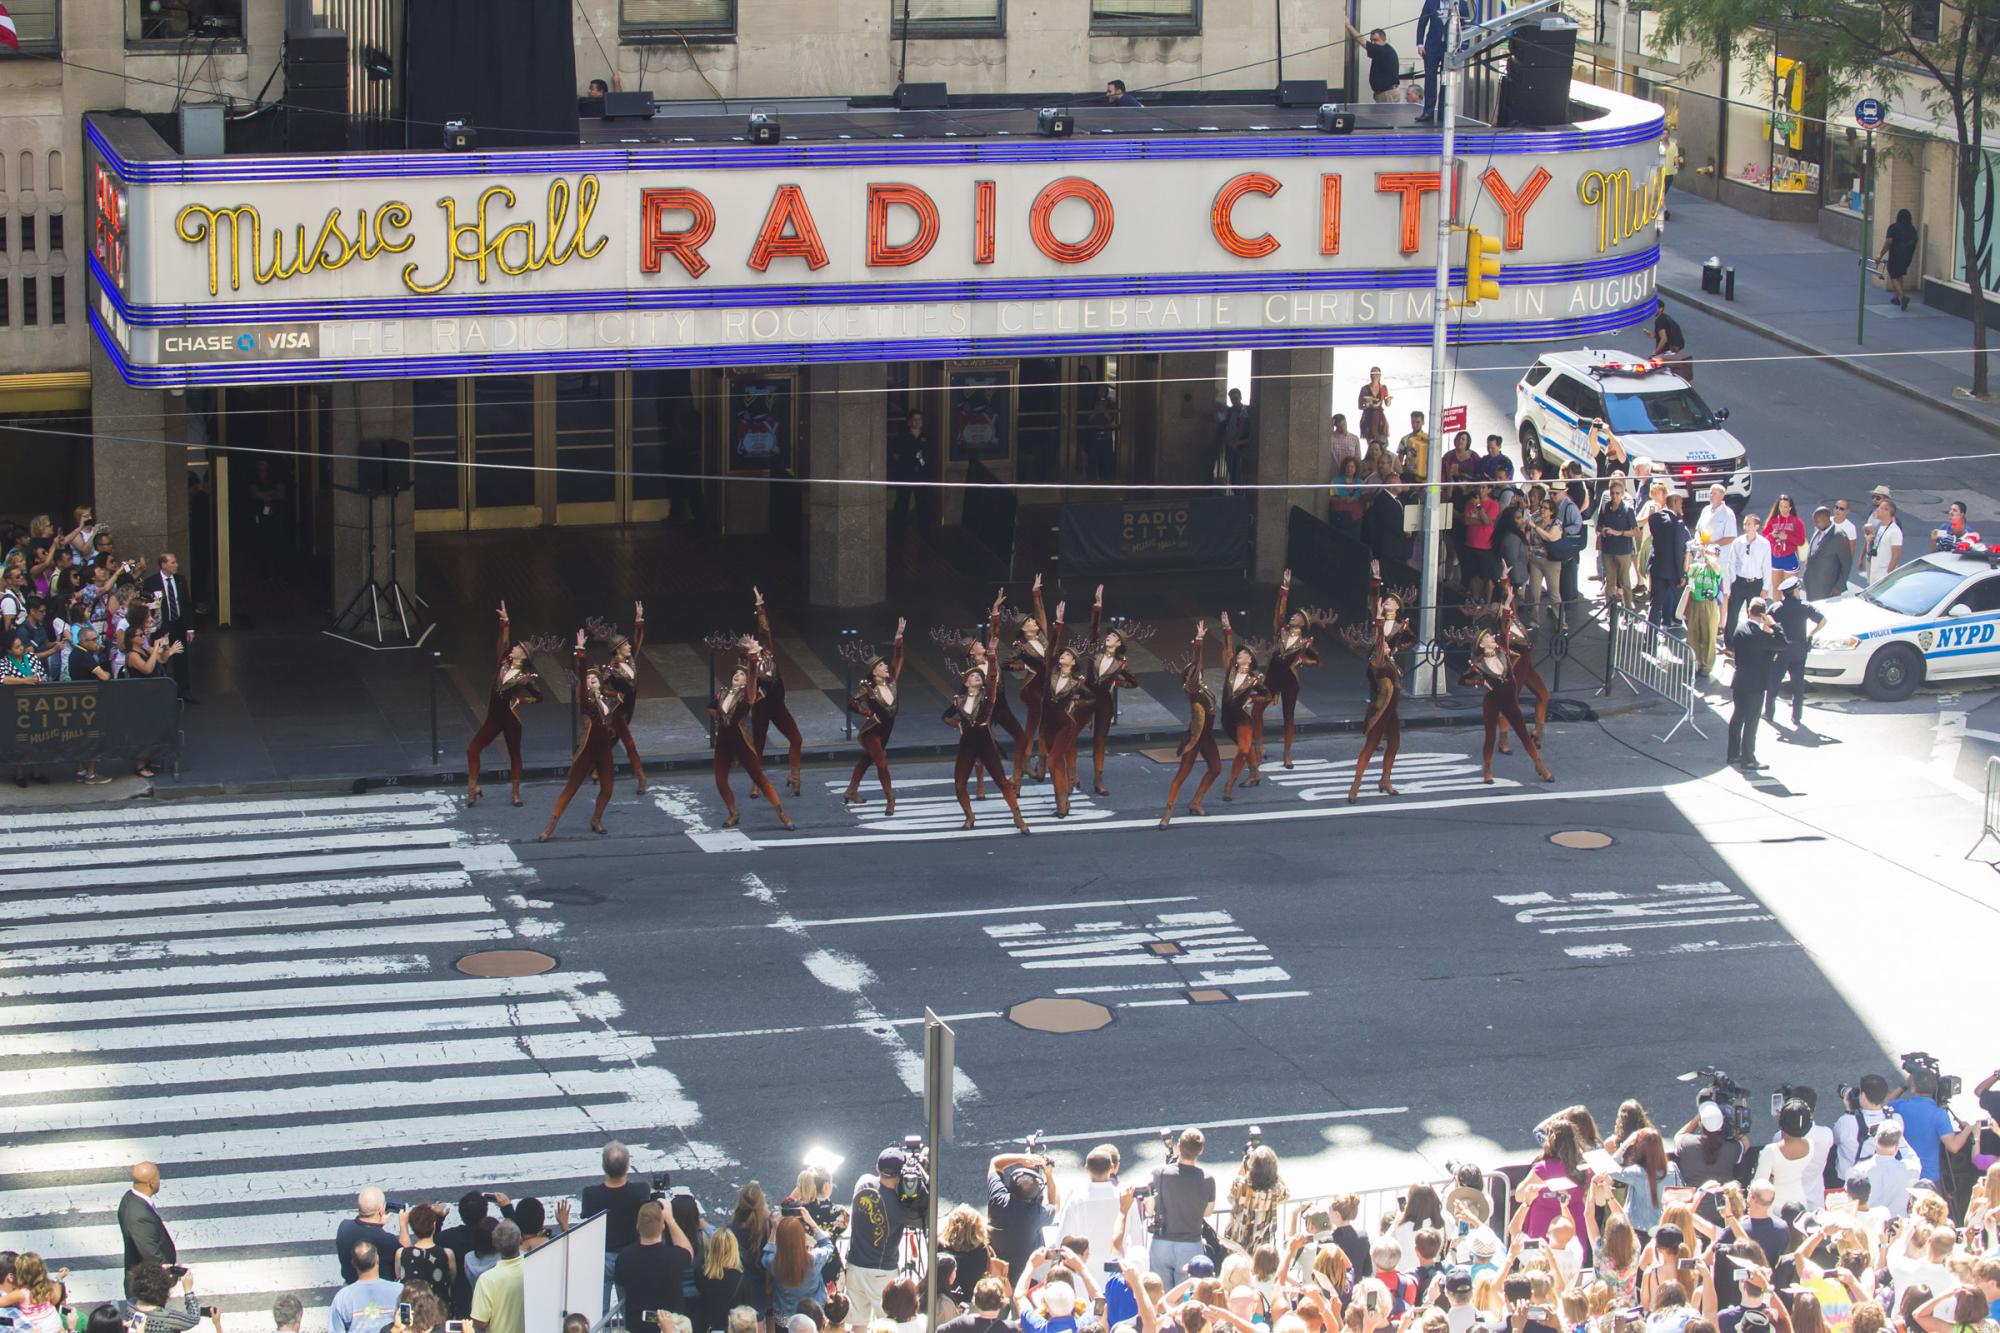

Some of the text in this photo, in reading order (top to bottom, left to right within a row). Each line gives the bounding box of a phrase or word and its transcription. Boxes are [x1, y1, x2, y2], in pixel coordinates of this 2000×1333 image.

[640, 166, 1553, 279] RADIO CITY
[175, 200, 414, 296] Music
[403, 174, 608, 294] Hall
[322, 321, 400, 355] THE
[435, 315, 565, 350] RADIO
[599, 312, 692, 344] CITY
[725, 304, 967, 338] ROCKETTES
[1001, 296, 1232, 331] CELEBRATE
[1515, 287, 1544, 315] IN
[165, 332, 311, 352] CHASE VISA
[1123, 511, 1188, 526] RADIO
[1122, 524, 1187, 539] CITY
[1869, 628, 1891, 639] POLICE
[1936, 623, 1995, 648] NYPD
[17, 695, 97, 713] RADIO
[17, 711, 96, 729] CITY
[30, 728, 85, 744] MUSIC HALL
